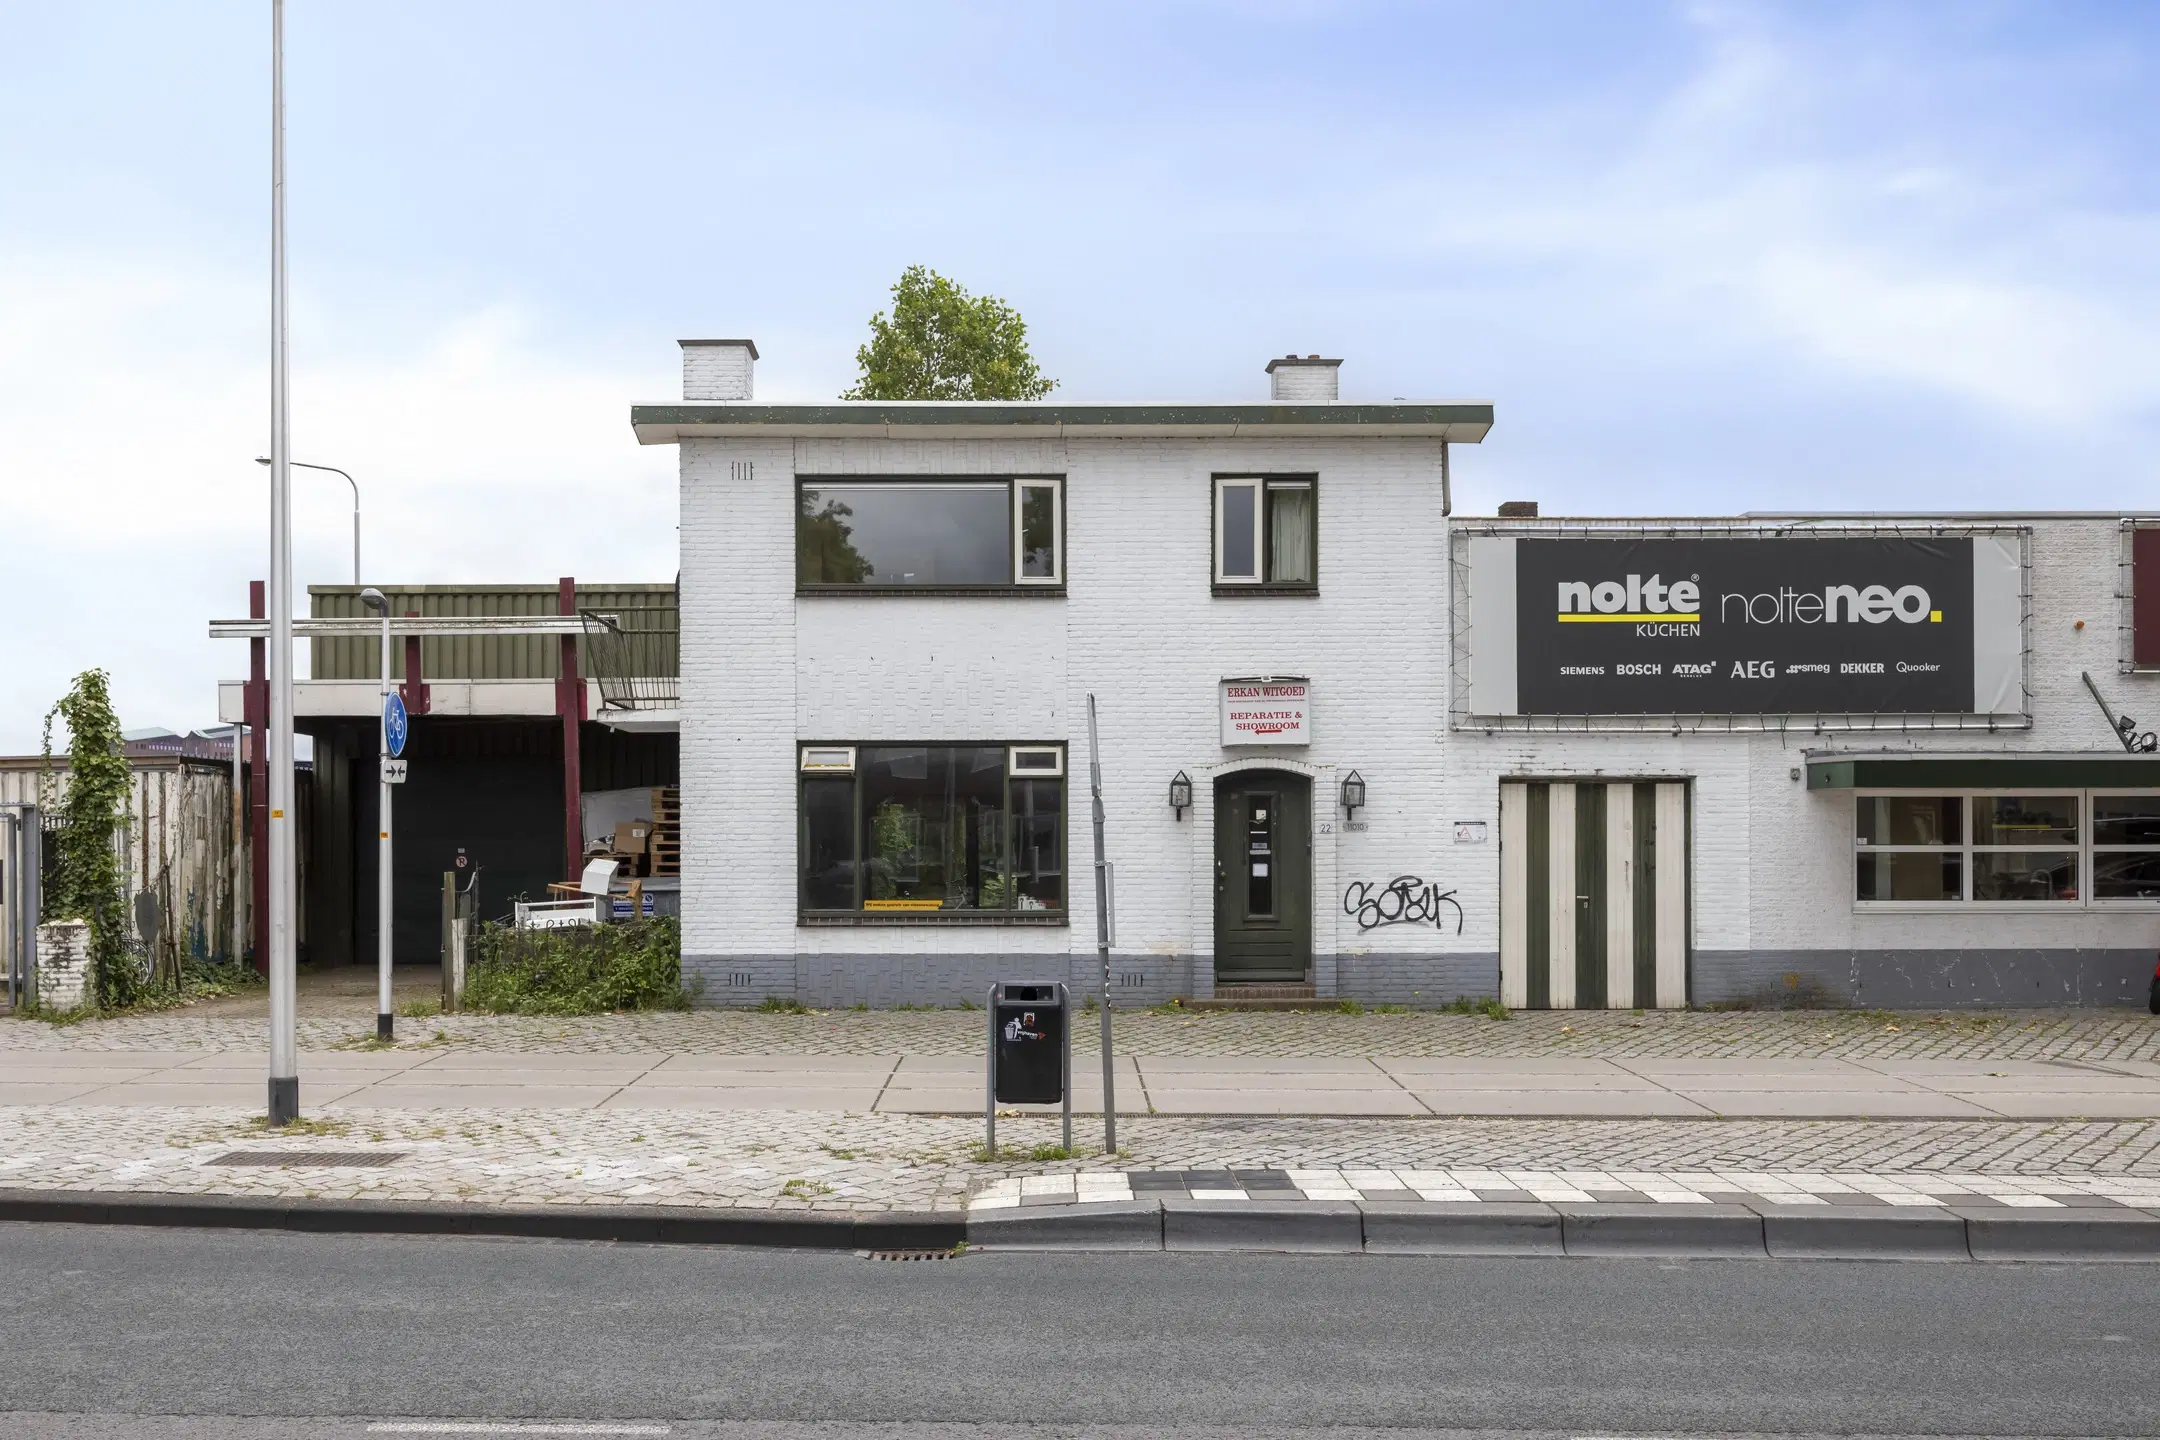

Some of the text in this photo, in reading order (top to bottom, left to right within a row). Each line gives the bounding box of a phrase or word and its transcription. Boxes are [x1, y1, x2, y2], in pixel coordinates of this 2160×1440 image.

[1637, 622, 1700, 636] KÜCHEN
[1617, 664, 1661, 675] BOSCH
[1672, 664, 1712, 674] ATAG
[1731, 661, 1775, 678] AEG
[1801, 664, 1831, 673] smeg
[1841, 663, 1884, 673] DEKKER
[1896, 662, 1940, 673] Quooker
[1227, 686, 1305, 697] ERKAN WITGOED
[1230, 711, 1292, 719] REPARATIE
[1235, 722, 1300, 730] SHOWROOM
[1320, 824, 1331, 832] 22
